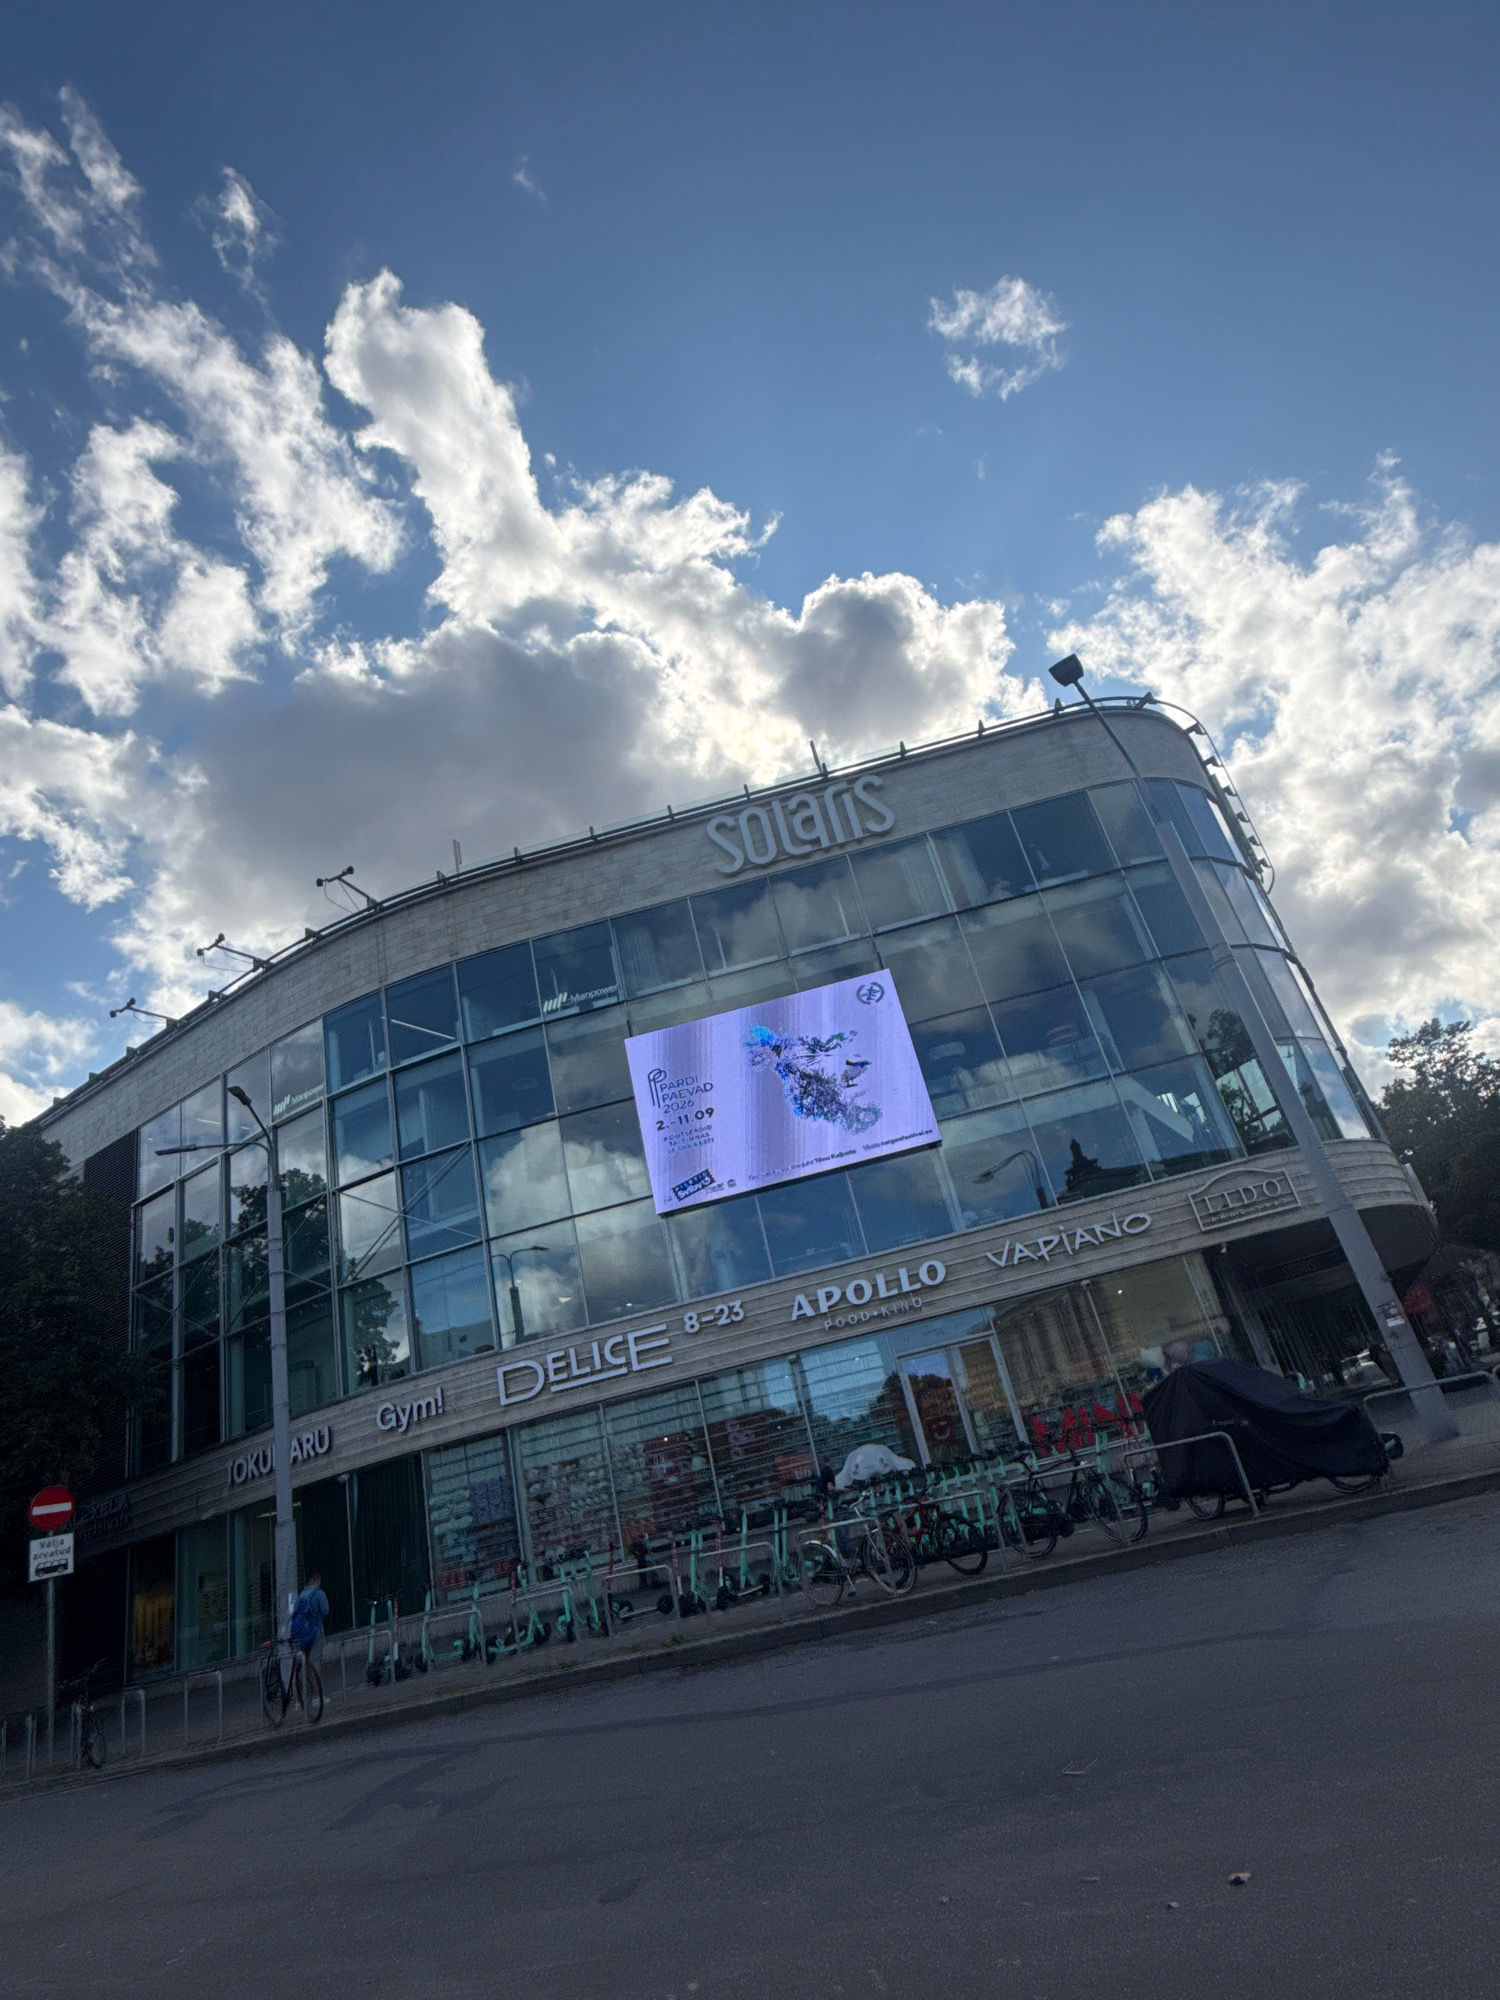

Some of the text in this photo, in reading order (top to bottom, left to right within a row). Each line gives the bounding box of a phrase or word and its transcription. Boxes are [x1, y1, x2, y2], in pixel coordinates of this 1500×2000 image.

[663, 1098, 695, 1114] 2026
[1201, 1179, 1281, 1214] LIDO
[791, 1260, 946, 1321] APOLLO
[376, 1384, 444, 1433] Gym!
[226, 1425, 331, 1487] TOKUARU
